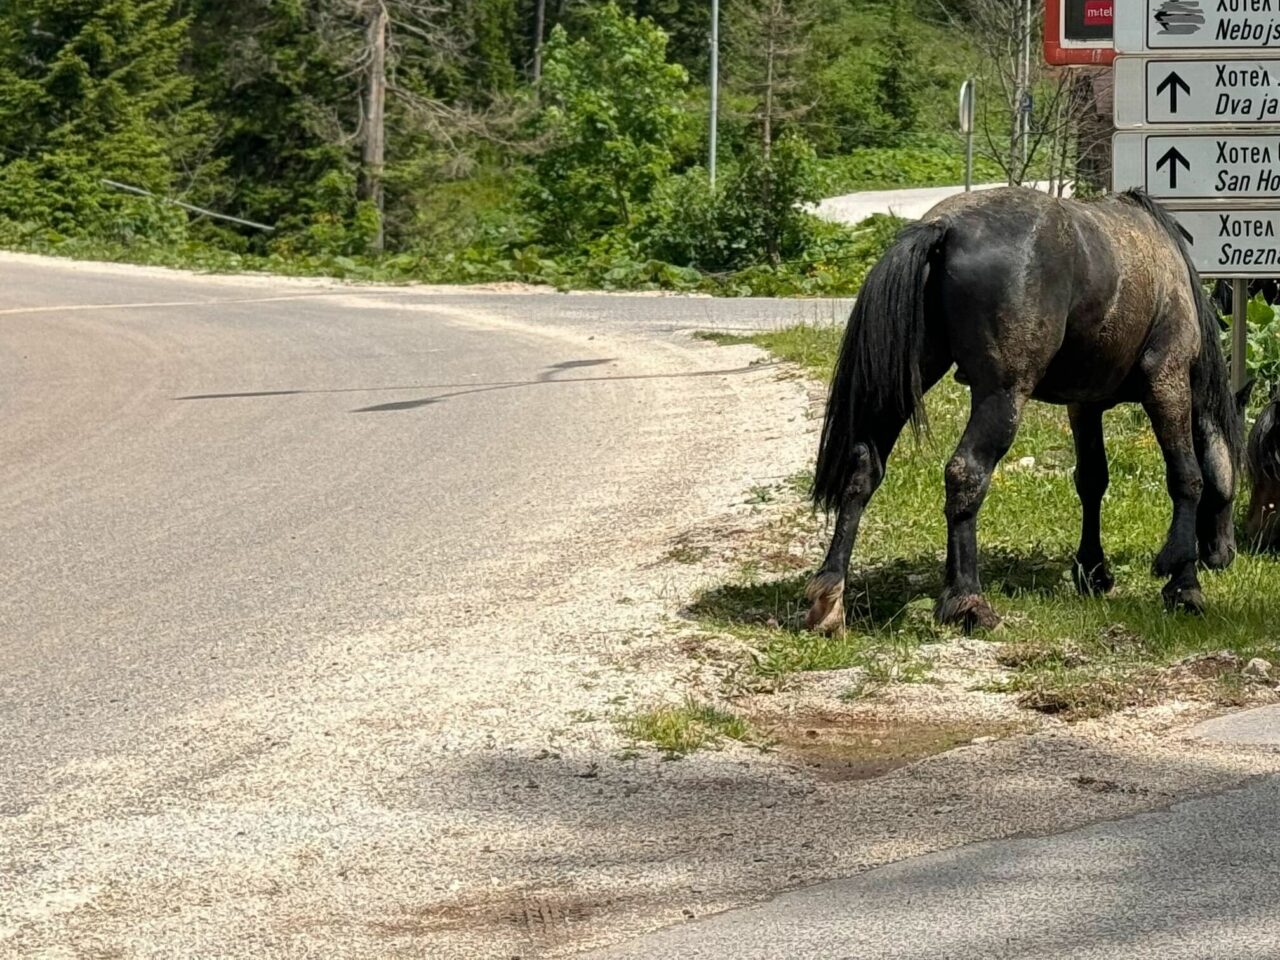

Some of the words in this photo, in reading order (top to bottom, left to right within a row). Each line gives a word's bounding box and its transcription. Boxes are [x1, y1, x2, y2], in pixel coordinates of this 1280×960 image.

[1215, 64, 1271, 87] Хотел
[1215, 93, 1252, 115] Dva
[1215, 140, 1271, 164] Хотел
[1214, 169, 1251, 192] San
[1218, 213, 1275, 237] Хотел
